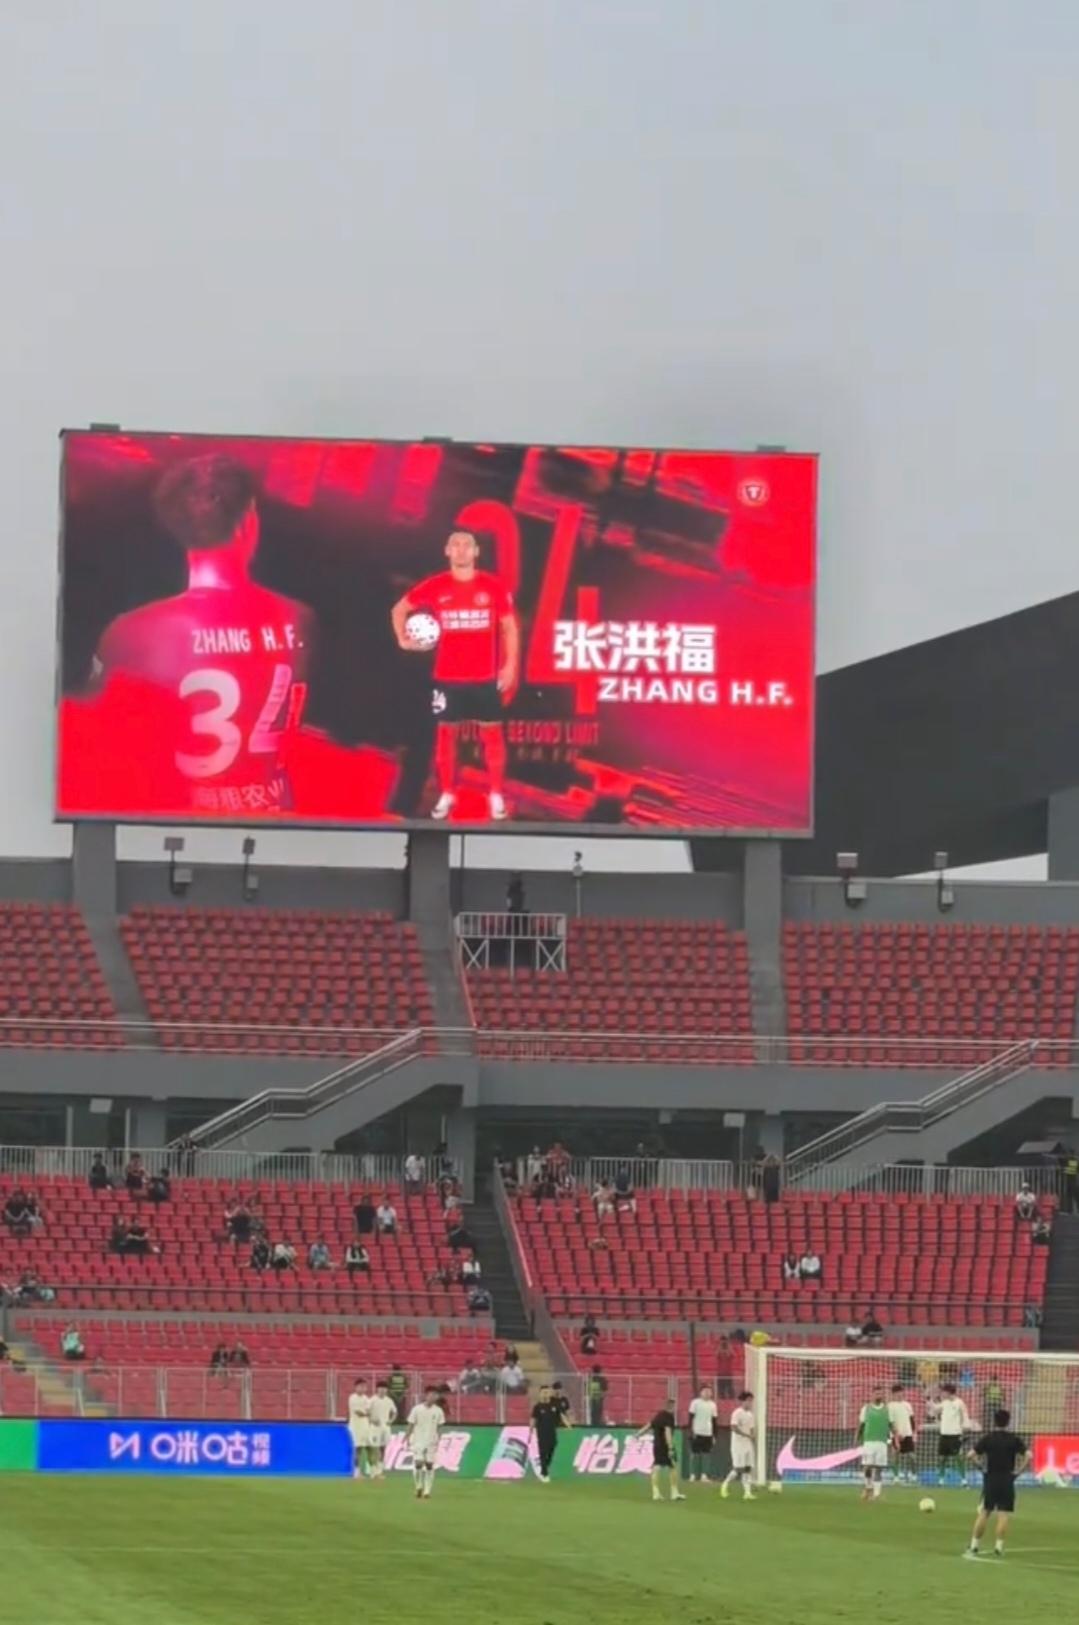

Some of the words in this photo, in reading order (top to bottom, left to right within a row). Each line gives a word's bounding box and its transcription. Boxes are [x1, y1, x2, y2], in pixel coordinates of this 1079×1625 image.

[192, 628, 251, 654] ZHANG
[553, 619, 716, 674] 张洪福
[598, 677, 718, 704] ZHANG
[731, 681, 793, 706] H.F.
